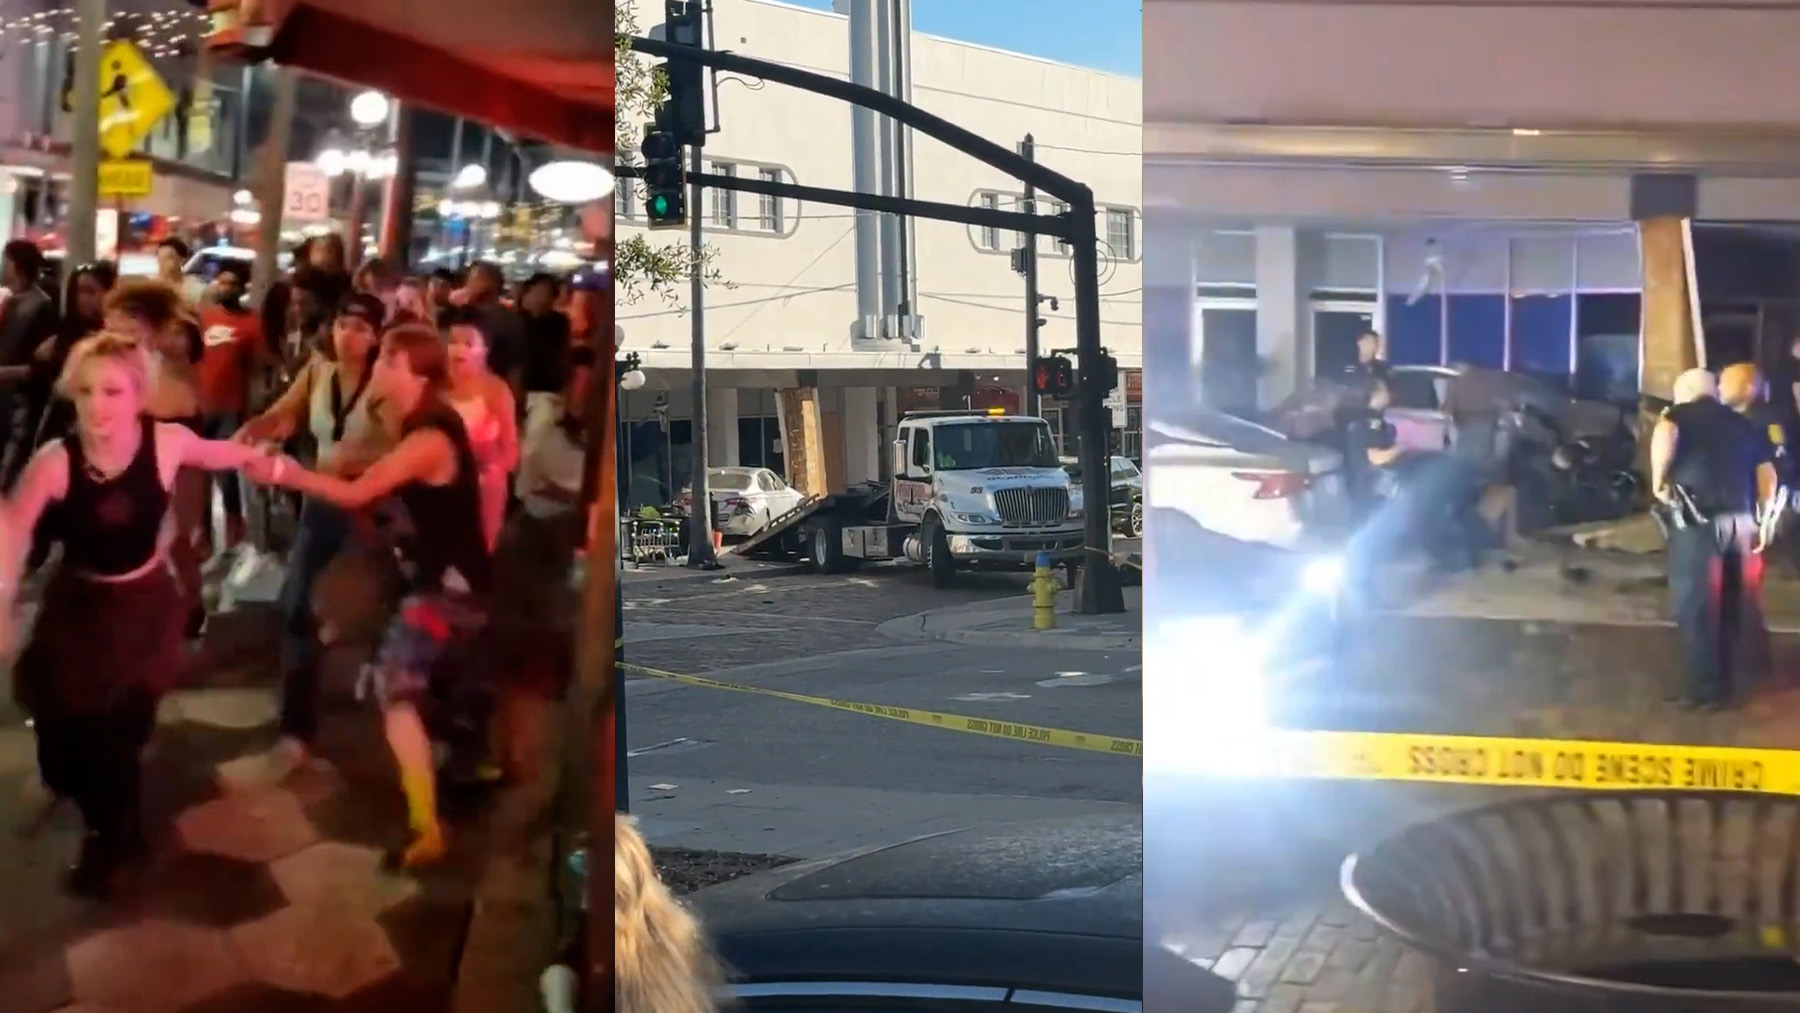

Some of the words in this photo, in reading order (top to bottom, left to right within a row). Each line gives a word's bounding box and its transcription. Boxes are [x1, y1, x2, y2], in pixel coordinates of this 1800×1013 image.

[289, 190, 320, 213] 30
[1408, 745, 1487, 777] CROSS
[1496, 748, 1544, 780] NOT
[1554, 750, 1585, 781] DO
[1597, 753, 1672, 784] SCENE
[1685, 757, 1764, 789] CRIME
